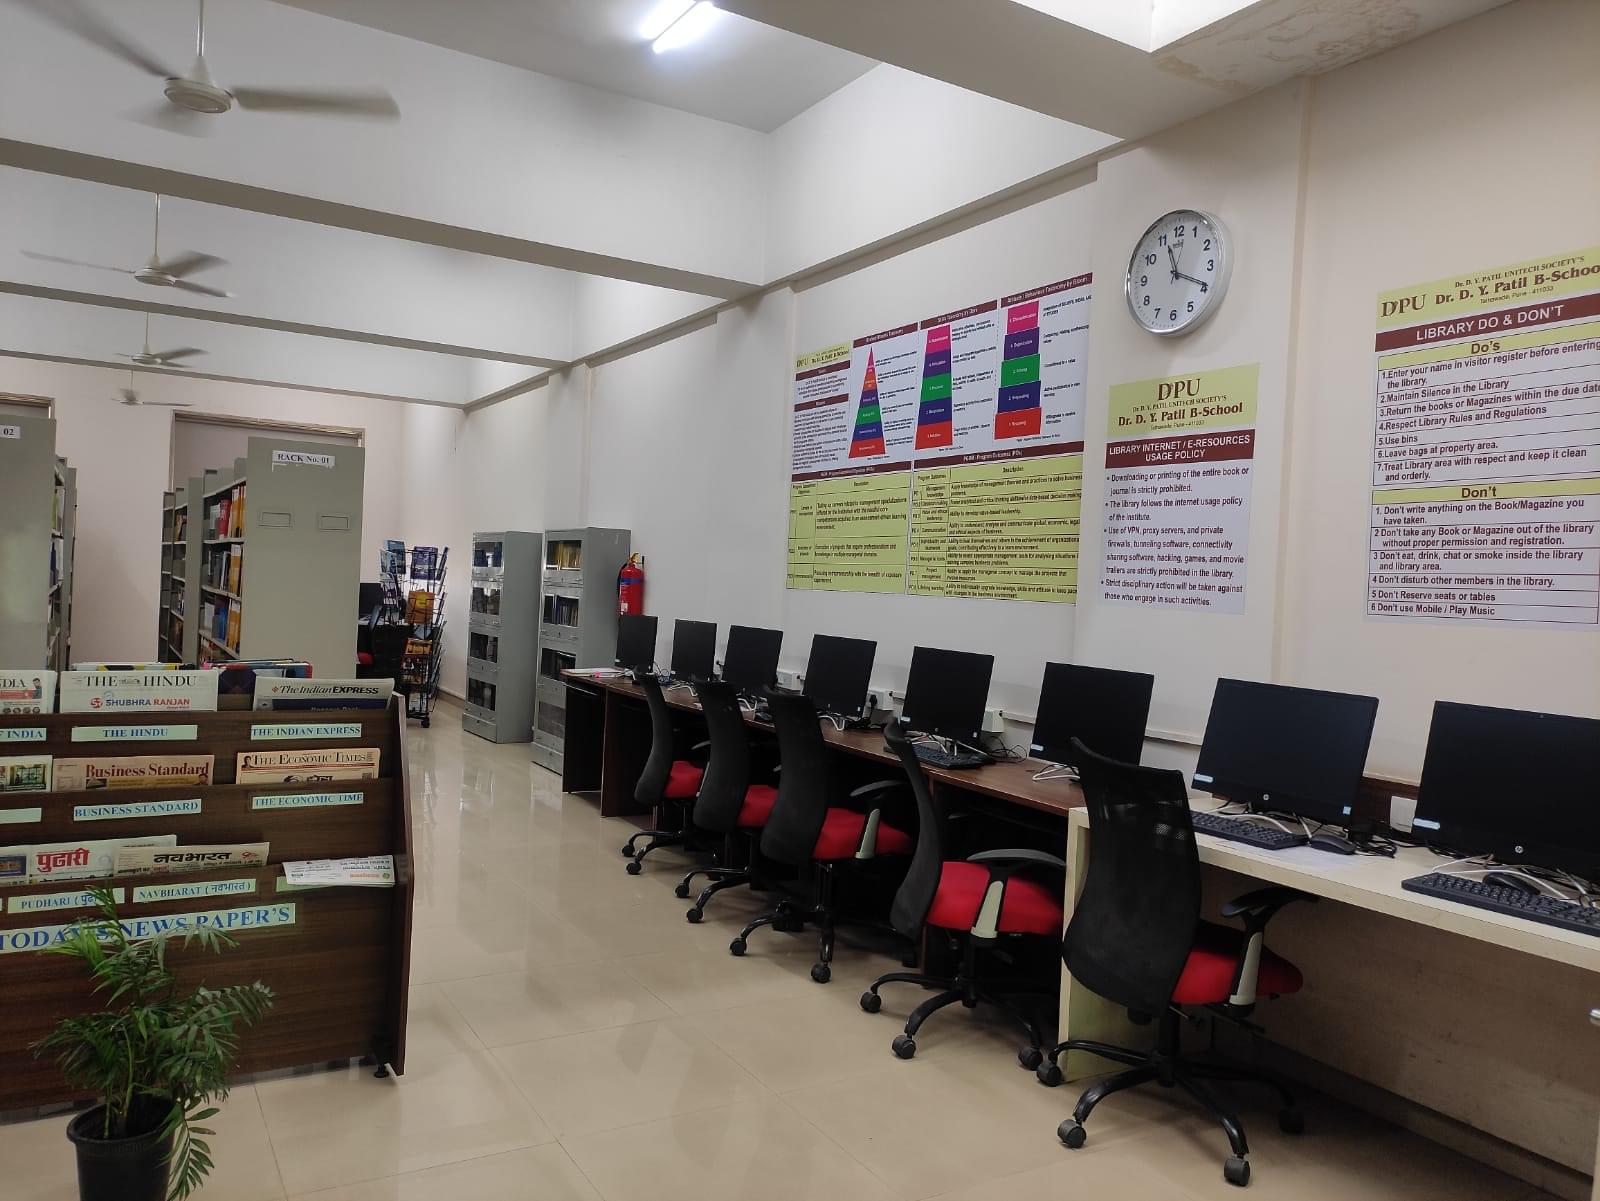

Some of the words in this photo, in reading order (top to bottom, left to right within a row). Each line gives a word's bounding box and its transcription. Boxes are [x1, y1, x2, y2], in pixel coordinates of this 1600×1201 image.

[1174, 225, 1185, 237] 12
[1192, 226, 1197, 237] 1
[1158, 234, 1167, 246] 11
[1203, 239, 1210, 251] 2
[1145, 254, 1156, 266] 10
[1207, 260, 1213, 271] 3
[1141, 275, 1147, 286] 9
[1200, 283, 1207, 293] 4
[1381, 294, 1427, 317] DPU
[1435, 294, 1454, 304] Dr.
[1460, 290, 1473, 300] D.
[1478, 286, 1488, 296] Y.
[1495, 277, 1527, 293] Patil
[1534, 265, 1600, 285] B-Schoo
[1143, 296, 1150, 305] 8
[1187, 301, 1194, 312] 5
[1154, 308, 1161, 318] 7
[1170, 310, 1177, 320] 6
[1416, 321, 1474, 340] LIBRARY
[1478, 317, 1498, 329] DO
[1503, 315, 1512, 325] &
[1518, 305, 1564, 323] DON'T
[1471, 341, 1500, 354] Do's
[1382, 369, 1408, 379] 1.Enter
[1410, 366, 1428, 376] your
[1430, 364, 1452, 374] name
[1455, 360, 1462, 368] in
[1464, 356, 1491, 367] visitor
[1494, 353, 1527, 364] register
[1530, 348, 1559, 357] before
[1562, 341, 1600, 354] entering
[1158, 379, 1201, 400] DPU
[1388, 381, 1399, 389] the
[1402, 378, 1427, 387] library.
[1380, 392, 1419, 403] 2.Maintain
[1421, 388, 1450, 398] Silence
[1453, 386, 1460, 394] in
[1463, 383, 1476, 392] the
[1478, 380, 1509, 392] Library
[1118, 416, 1132, 426] Dr.
[1136, 414, 1146, 423] D.
[1150, 413, 1157, 422] Y.
[1161, 409, 1185, 421] Patil
[1190, 402, 1243, 418] B-School
[1379, 420, 1417, 431] 4.Respect
[1419, 417, 1447, 428] Library
[1450, 415, 1472, 423] Rules
[1475, 412, 1490, 421] and
[1494, 406, 1547, 420] Regulations
[1109, 445, 1140, 455] LIBRARY
[1142, 441, 1181, 452] INTERNET
[1183, 440, 1186, 449] /
[1188, 435, 1250, 448] E-RESOURCES
[1402, 435, 1417, 443] bins
[1146, 451, 1172, 461] USAGE
[1175, 449, 1205, 460] POLICY
[1378, 448, 1406, 458] 6.Leave
[1409, 447, 1428, 457] bags
[1430, 445, 1437, 454] at
[1440, 442, 1475, 454] property
[1477, 441, 1498, 449] area.
[1377, 461, 1403, 471] 7.Treat
[1405, 460, 1432, 471] Library
[1435, 458, 1452, 467] area
[1454, 456, 1472, 465] with
[1474, 454, 1507, 464] respect
[1509, 453, 1525, 461] and
[1527, 451, 1550, 461] keep
[1553, 450, 1558, 458] it
[1561, 449, 1586, 458] clean
[1111, 473, 1148, 482] Downloading
[1158, 469, 1181, 479] printing
[1183, 469, 1190, 477] of
[1223, 467, 1240, 475] book
[1242, 467, 1249, 475] or
[1386, 473, 1400, 481] and
[1402, 471, 1430, 481] orderly.
[1461, 486, 1497, 498] Don't
[1376, 507, 1382, 515] 1.
[1384, 506, 1404, 515] Don't
[1406, 504, 1425, 513] write
[1428, 502, 1462, 514] anything
[1466, 503, 1476, 511] on
[1478, 502, 1492, 510] the
[1495, 500, 1563, 510] Book/Magazine
[1566, 499, 1584, 510] you
[1383, 516, 1401, 525] have
[1404, 515, 1427, 524] taken.
[1109, 526, 1119, 535] Use
[1142, 527, 1159, 535] proxy
[1161, 527, 1186, 535] servers,
[1187, 526, 1199, 534] and
[1201, 526, 1223, 535] private
[1372, 575, 1377, 583] 4
[1379, 575, 1399, 584] Don't
[1401, 575, 1428, 584] disturb
[1430, 575, 1452, 585] other
[1454, 576, 1494, 586] members
[1496, 576, 1504, 585] in
[1507, 576, 1521, 585] the
[1524, 575, 1555, 587] library.
[1372, 590, 1376, 598] 5
[1378, 590, 1398, 599] Don't
[1400, 590, 1432, 599] Reserve
[1434, 592, 1456, 600] seats
[1459, 592, 1468, 600] or
[1470, 591, 1496, 601] tables
[84, 676, 118, 686] THE
[144, 675, 197, 686] HINDU
[106, 698, 151, 706] SHUBHRA
[154, 698, 190, 706] RANJAN
[8, 730, 43, 738] INDIA
[131, 729, 168, 737] HINDU
[252, 728, 274, 736] THE
[276, 727, 313, 736] INDIAN
[316, 726, 361, 735] EXPRESS
[254, 754, 276, 765] THE
[279, 752, 332, 765] ECONOMIC
[335, 751, 366, 763] TIMES
[86, 764, 145, 777] Business
[148, 762, 209, 776] Standard
[256, 798, 277, 806] THE
[279, 796, 334, 806] ECONOMIC
[338, 793, 363, 802] TIME
[75, 806, 132, 817] BUSINESS
[135, 802, 199, 813] STANDARD
[36, 848, 90, 872] पुढारी
[154, 852, 232, 864] नवभारत
[140, 887, 201, 899] NAVBHARAT
[21, 898, 70, 909] PUDHARI
[0, 927, 108, 950] TODAYS
[120, 918, 187, 938] NEWS
[196, 907, 289, 929] PAPER'S
